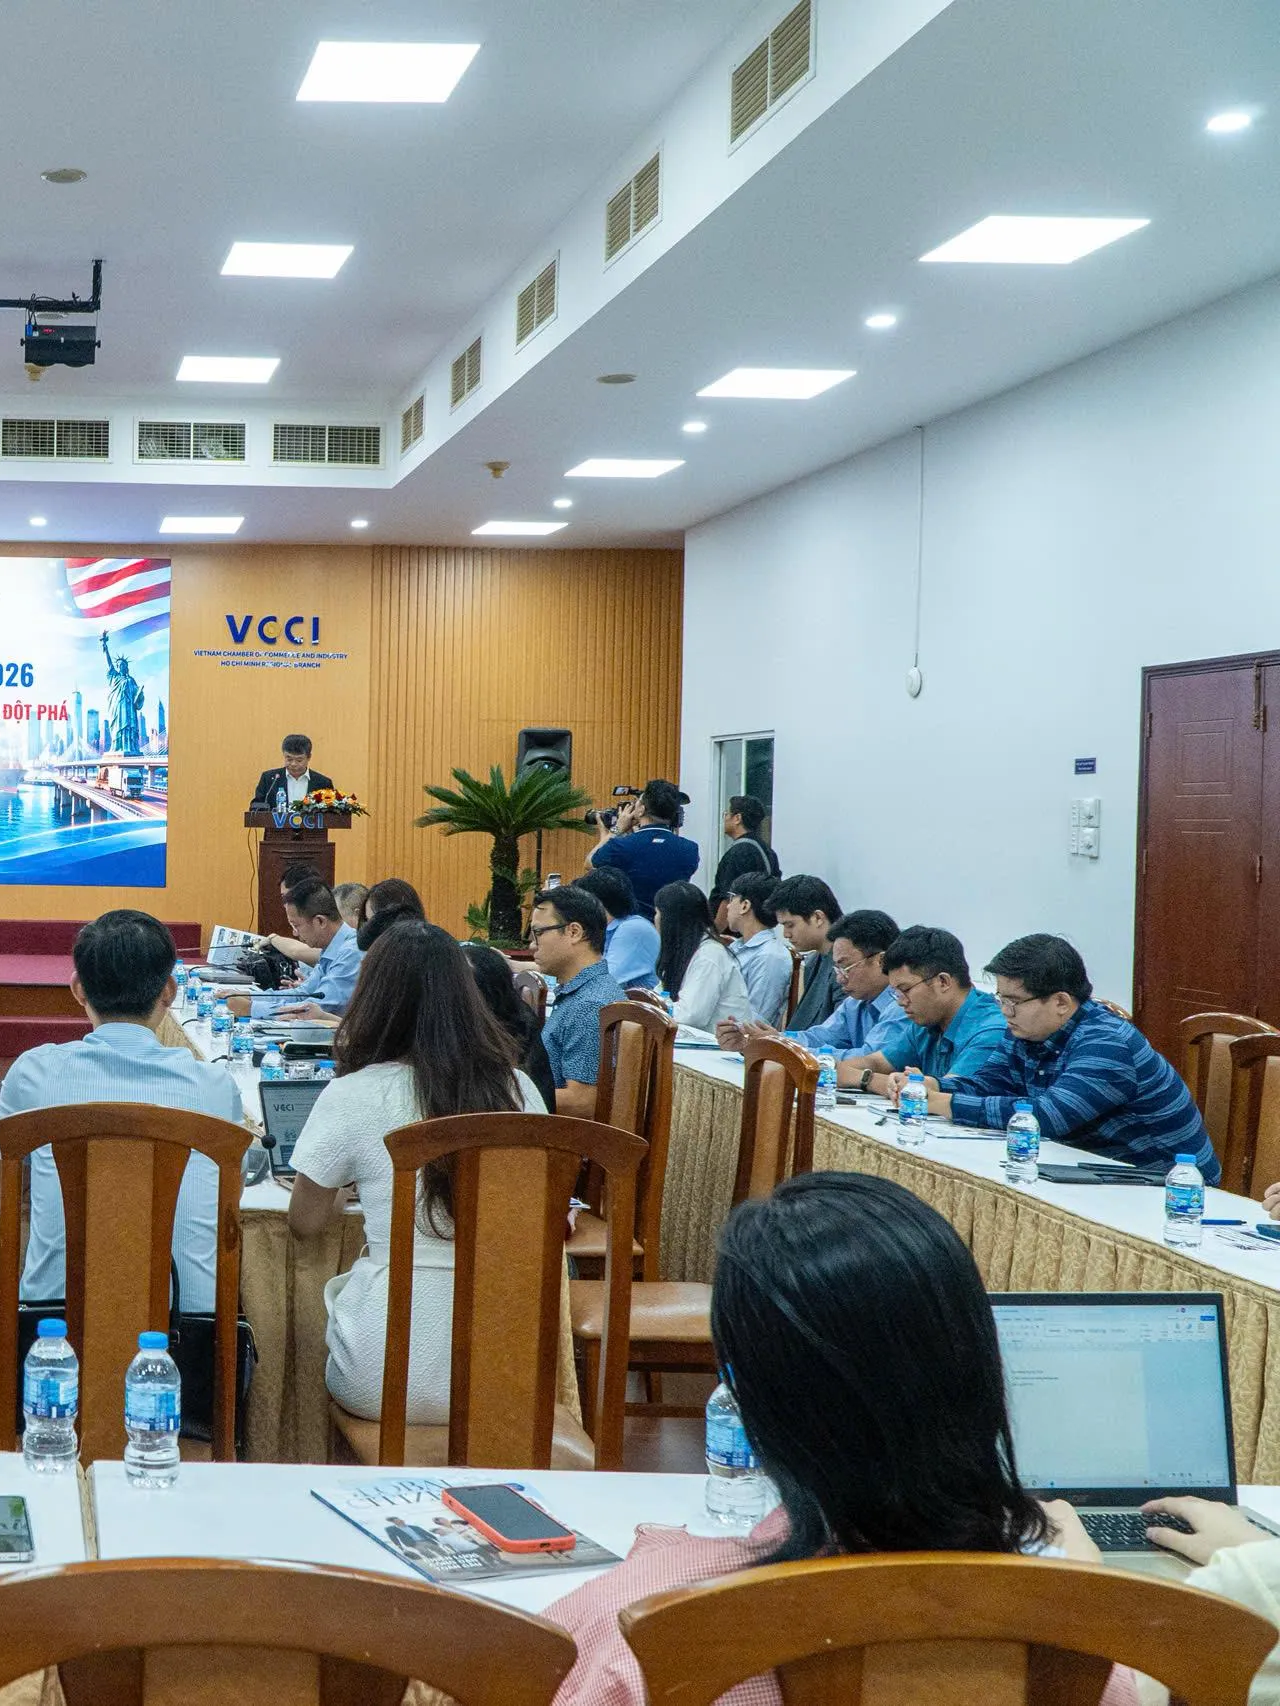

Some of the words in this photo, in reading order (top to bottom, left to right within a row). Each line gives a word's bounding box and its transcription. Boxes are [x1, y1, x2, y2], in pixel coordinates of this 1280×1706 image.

[225, 614, 320, 645] VCCI
[2, 700, 33, 724] ĐỘT
[37, 700, 69, 721] PHÁ
[272, 812, 325, 829] VCCI
